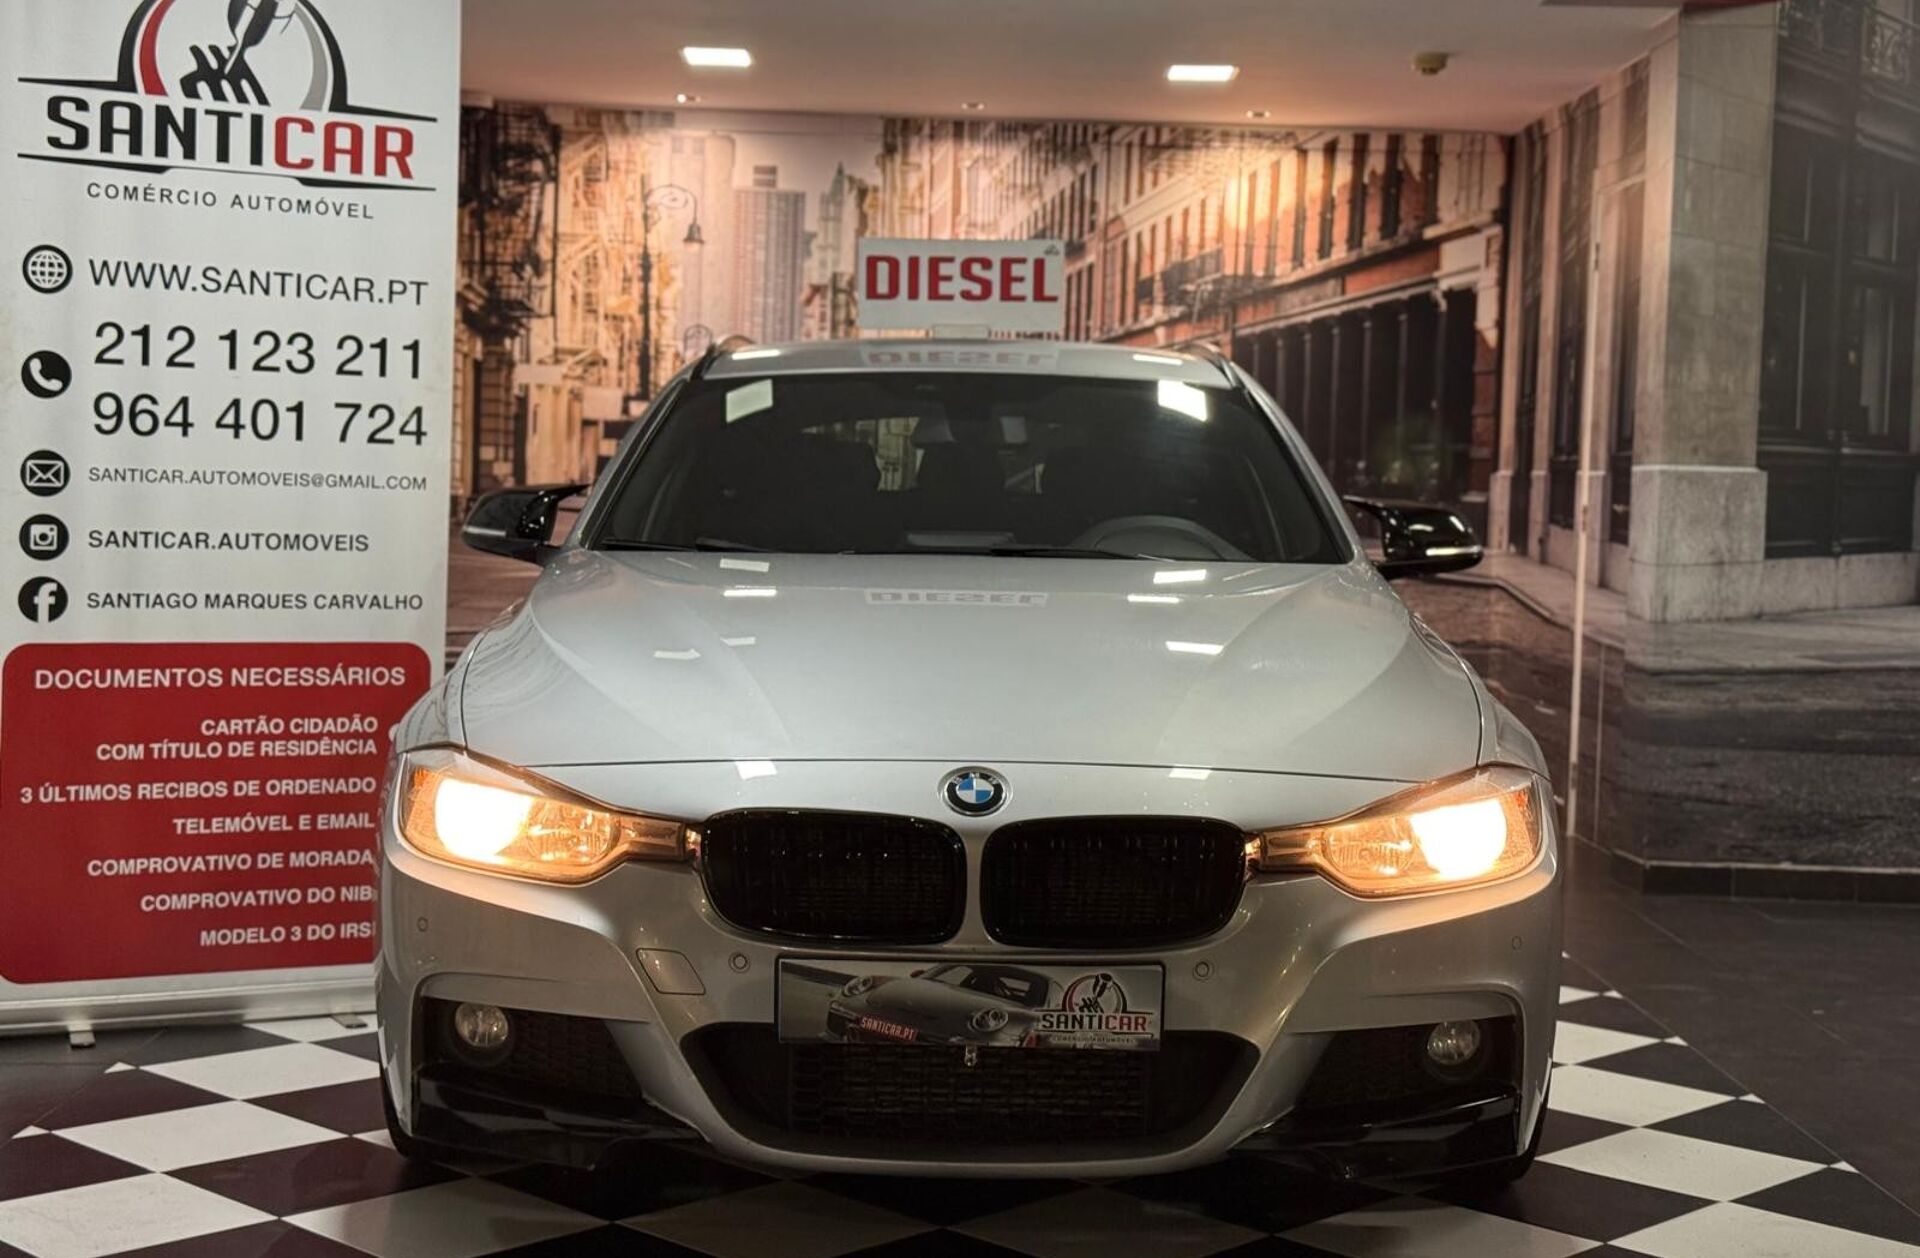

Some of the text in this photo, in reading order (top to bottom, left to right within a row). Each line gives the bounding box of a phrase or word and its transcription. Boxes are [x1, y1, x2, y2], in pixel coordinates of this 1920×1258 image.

[47, 95, 414, 179] SANTICAR
[87, 182, 373, 219] COMÉRCIO AUTOMÓVEL
[89, 258, 429, 306] WWW.SANTICAR.PT
[866, 255, 1058, 302] DIESEL
[94, 321, 421, 380] 212 123 211
[93, 391, 428, 446] 964 401 724
[89, 466, 427, 491] SANTICAR.AUTOMOVEIS@GMAIL.COM
[88, 529, 369, 552] SANTICAR.AUTOMOVEIS
[87, 592, 423, 610] SANTIAGO MARQUES CARVALHO
[35, 662, 406, 689] DOCUMENTOS NECESSÁRIOS
[201, 712, 379, 736] CARTÃO CIDADÃO
[97, 735, 377, 761] COM TÍTULO DE RESIDÊNCIA
[21, 777, 377, 803] 3 ÚLTIMOS RECIBOS DE ORDENADO
[173, 813, 375, 835] TELEMÓVEL E EMAIL
[87, 849, 374, 877] COMPROVATIVO DE MORADA
[141, 885, 372, 912] COMPROVATIVO DO NIB
[201, 921, 372, 946] MODELO 3 DO IRS
[1042, 1013, 1146, 1031] SANTICAR
